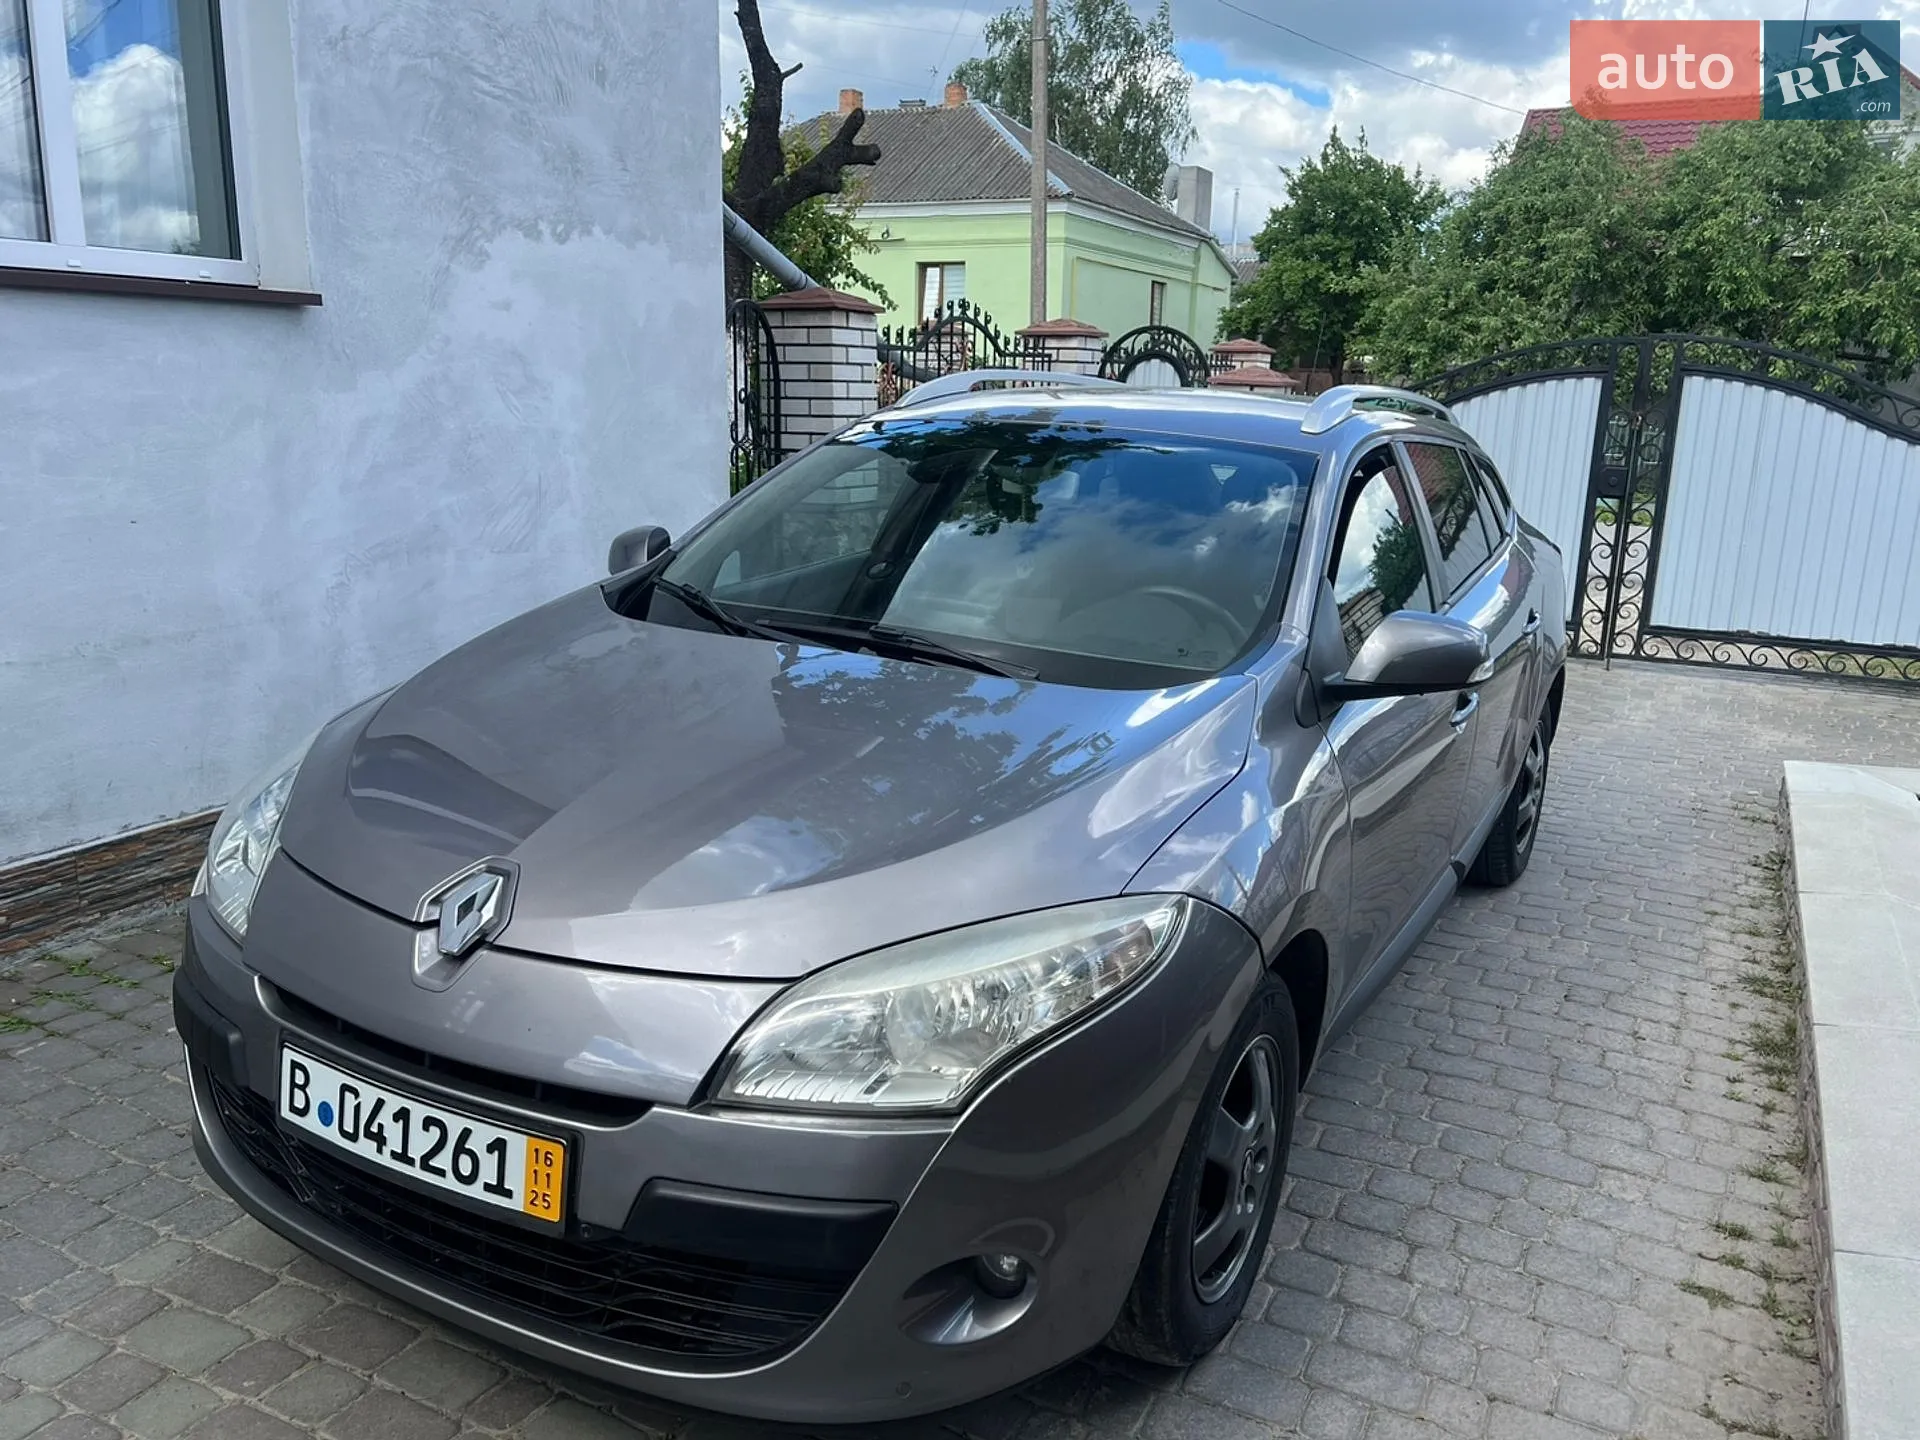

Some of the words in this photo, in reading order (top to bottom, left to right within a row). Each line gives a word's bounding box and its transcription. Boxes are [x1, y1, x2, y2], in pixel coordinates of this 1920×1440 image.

[288, 1059, 311, 1118] B
[337, 1082, 513, 1199] 041261
[533, 1147, 554, 1168] 16
[532, 1169, 552, 1188] 11
[529, 1190, 551, 1210] 25
